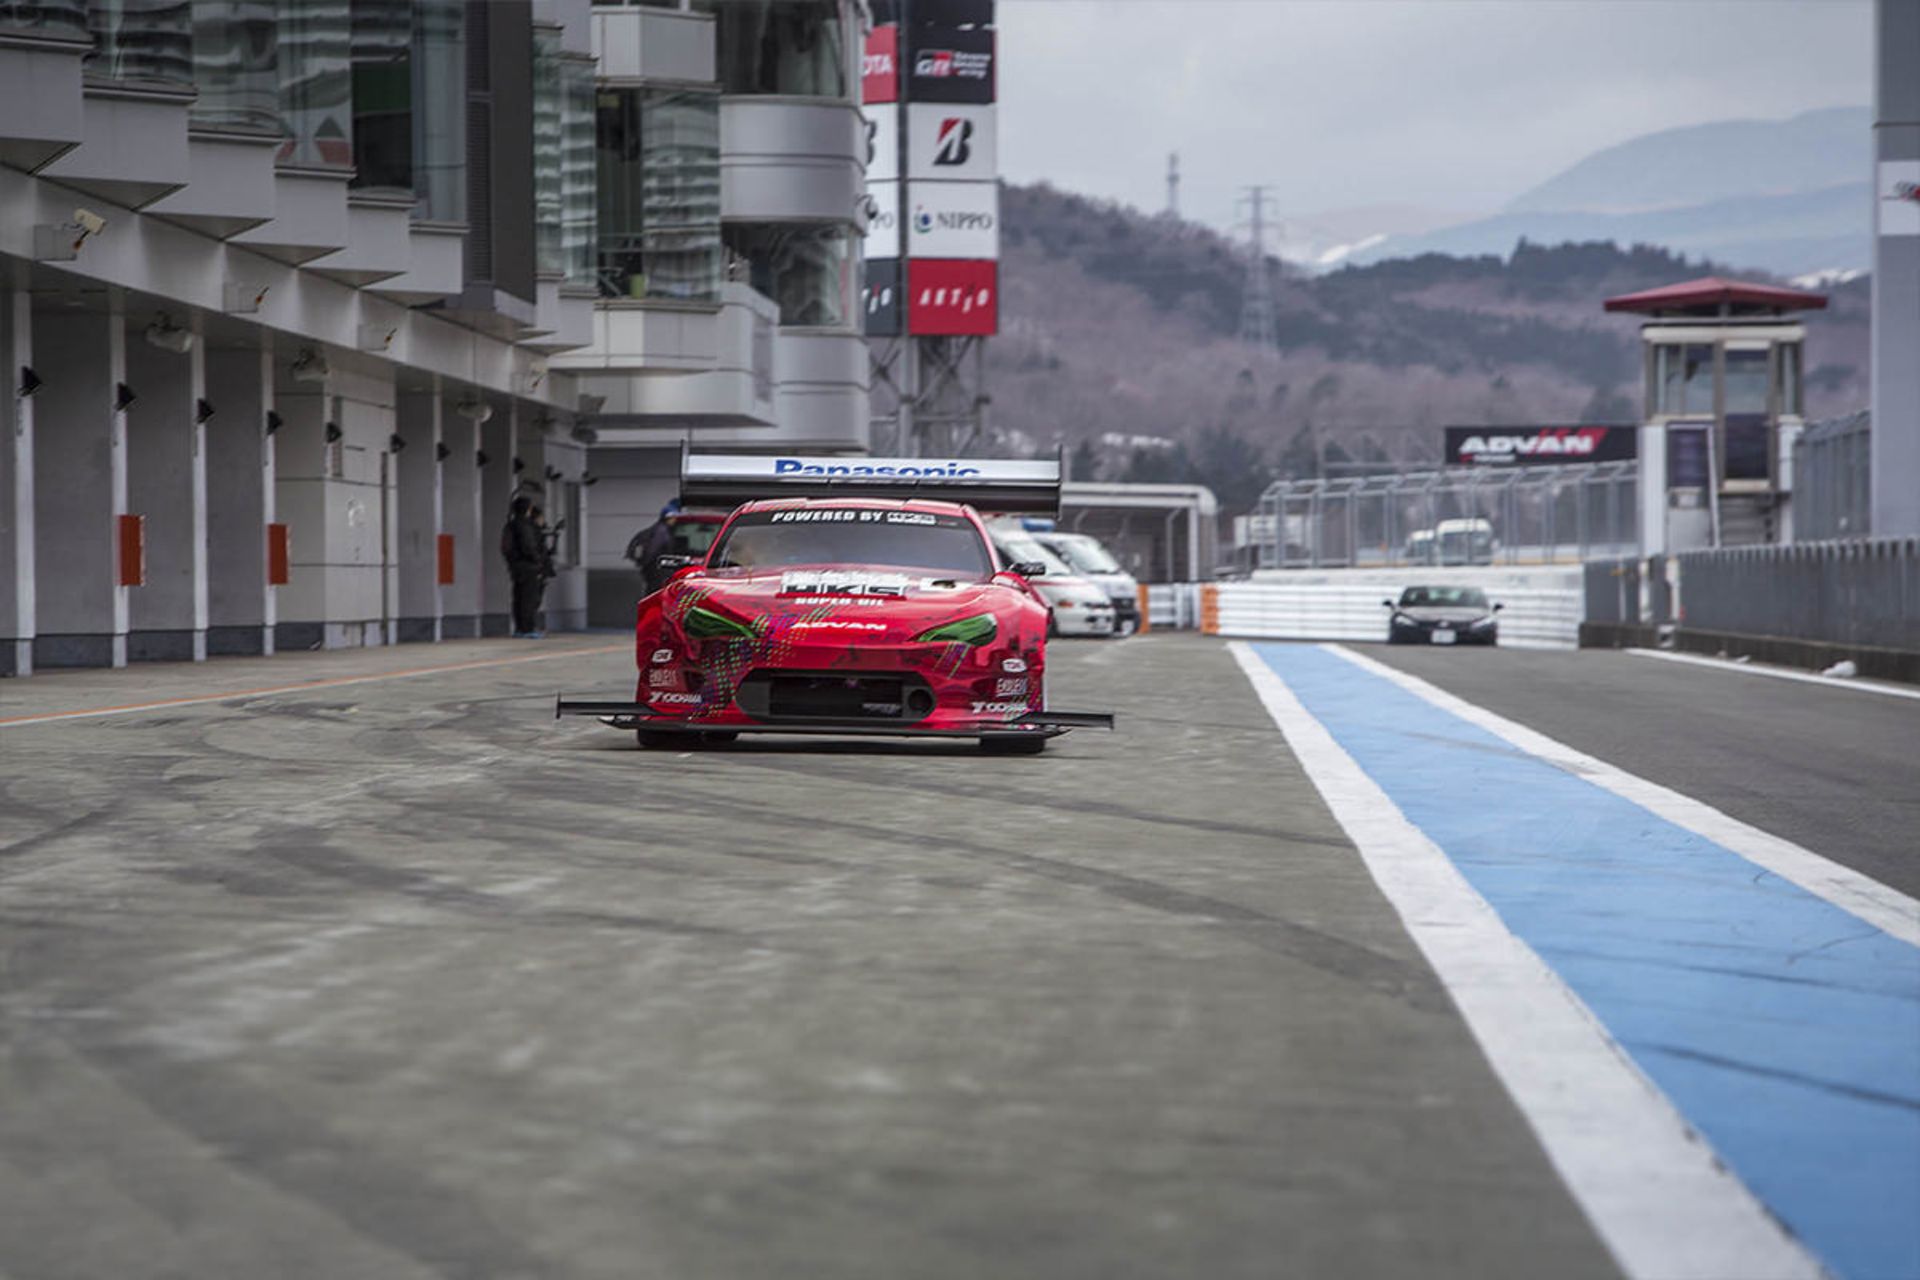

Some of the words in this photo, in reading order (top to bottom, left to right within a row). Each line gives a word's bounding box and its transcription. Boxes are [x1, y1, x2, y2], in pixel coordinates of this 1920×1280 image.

[936, 212, 993, 230] NIPPO
[1458, 433, 1593, 454] ADVAN
[775, 459, 981, 477] Panasonic
[771, 511, 854, 522] POWERED
[859, 511, 883, 522] BY
[790, 621, 887, 630] ADVAN
